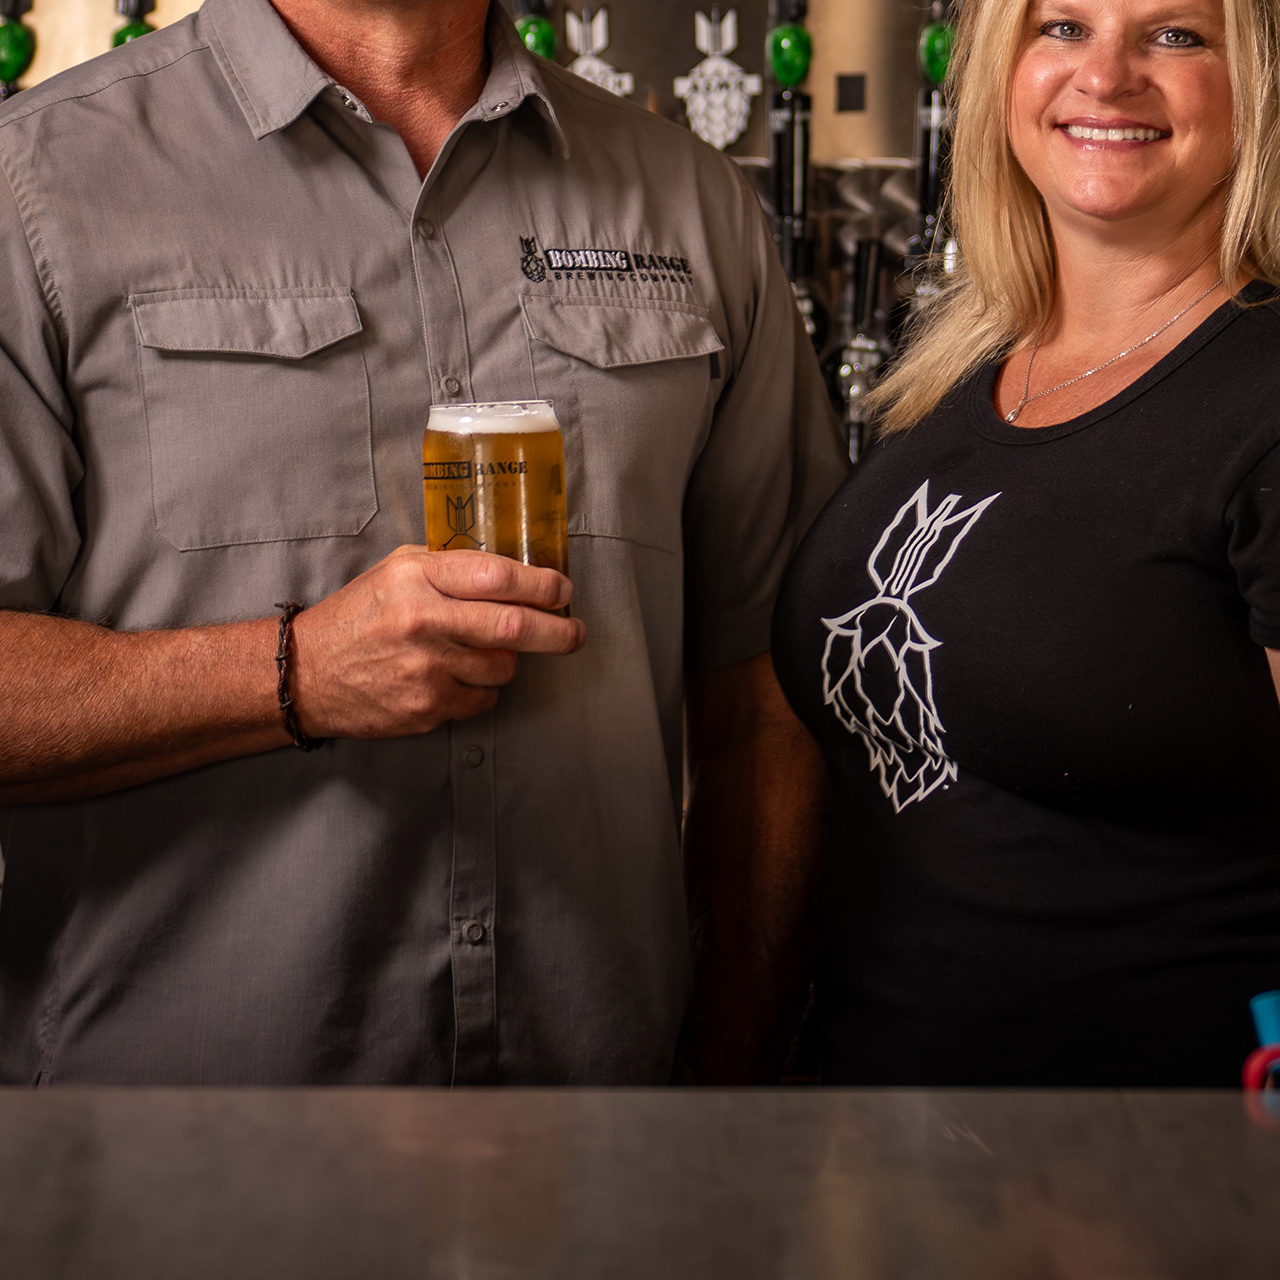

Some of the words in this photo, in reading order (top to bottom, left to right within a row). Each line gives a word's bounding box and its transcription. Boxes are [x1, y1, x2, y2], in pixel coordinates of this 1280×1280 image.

[548, 250, 628, 269] BOMBING
[633, 254, 691, 274] RANGE
[554, 272, 625, 282] BREWING
[629, 273, 693, 285] COMPANY
[475, 461, 528, 476] RANGE
